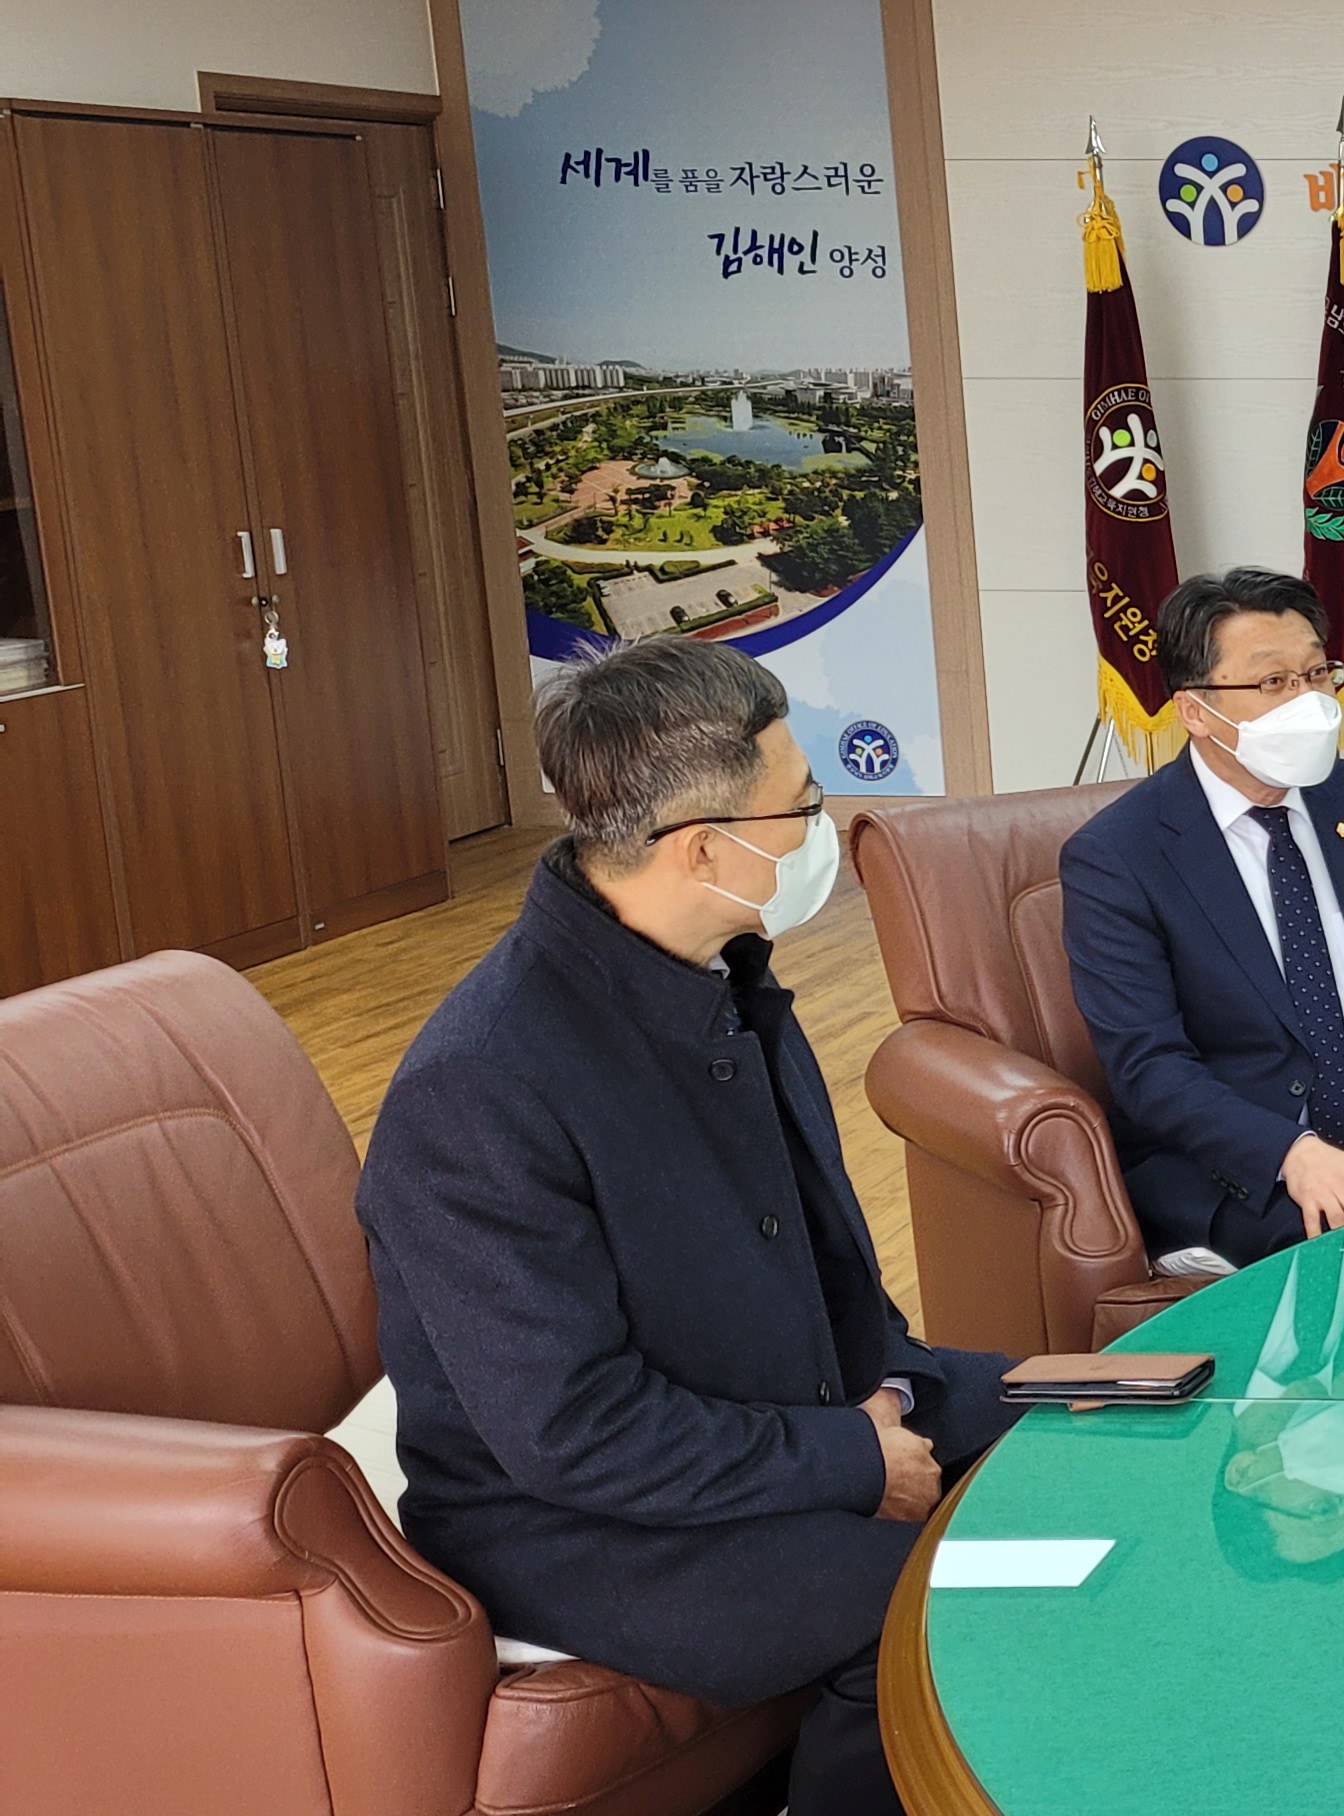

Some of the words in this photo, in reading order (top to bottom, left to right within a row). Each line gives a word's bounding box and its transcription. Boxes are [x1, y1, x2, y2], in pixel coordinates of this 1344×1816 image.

[559, 149, 673, 193] 세계를
[680, 168, 724, 194] 품을
[729, 162, 883, 195] 자랑스러운
[708, 227, 818, 279] 김해인
[830, 245, 888, 279] 양성
